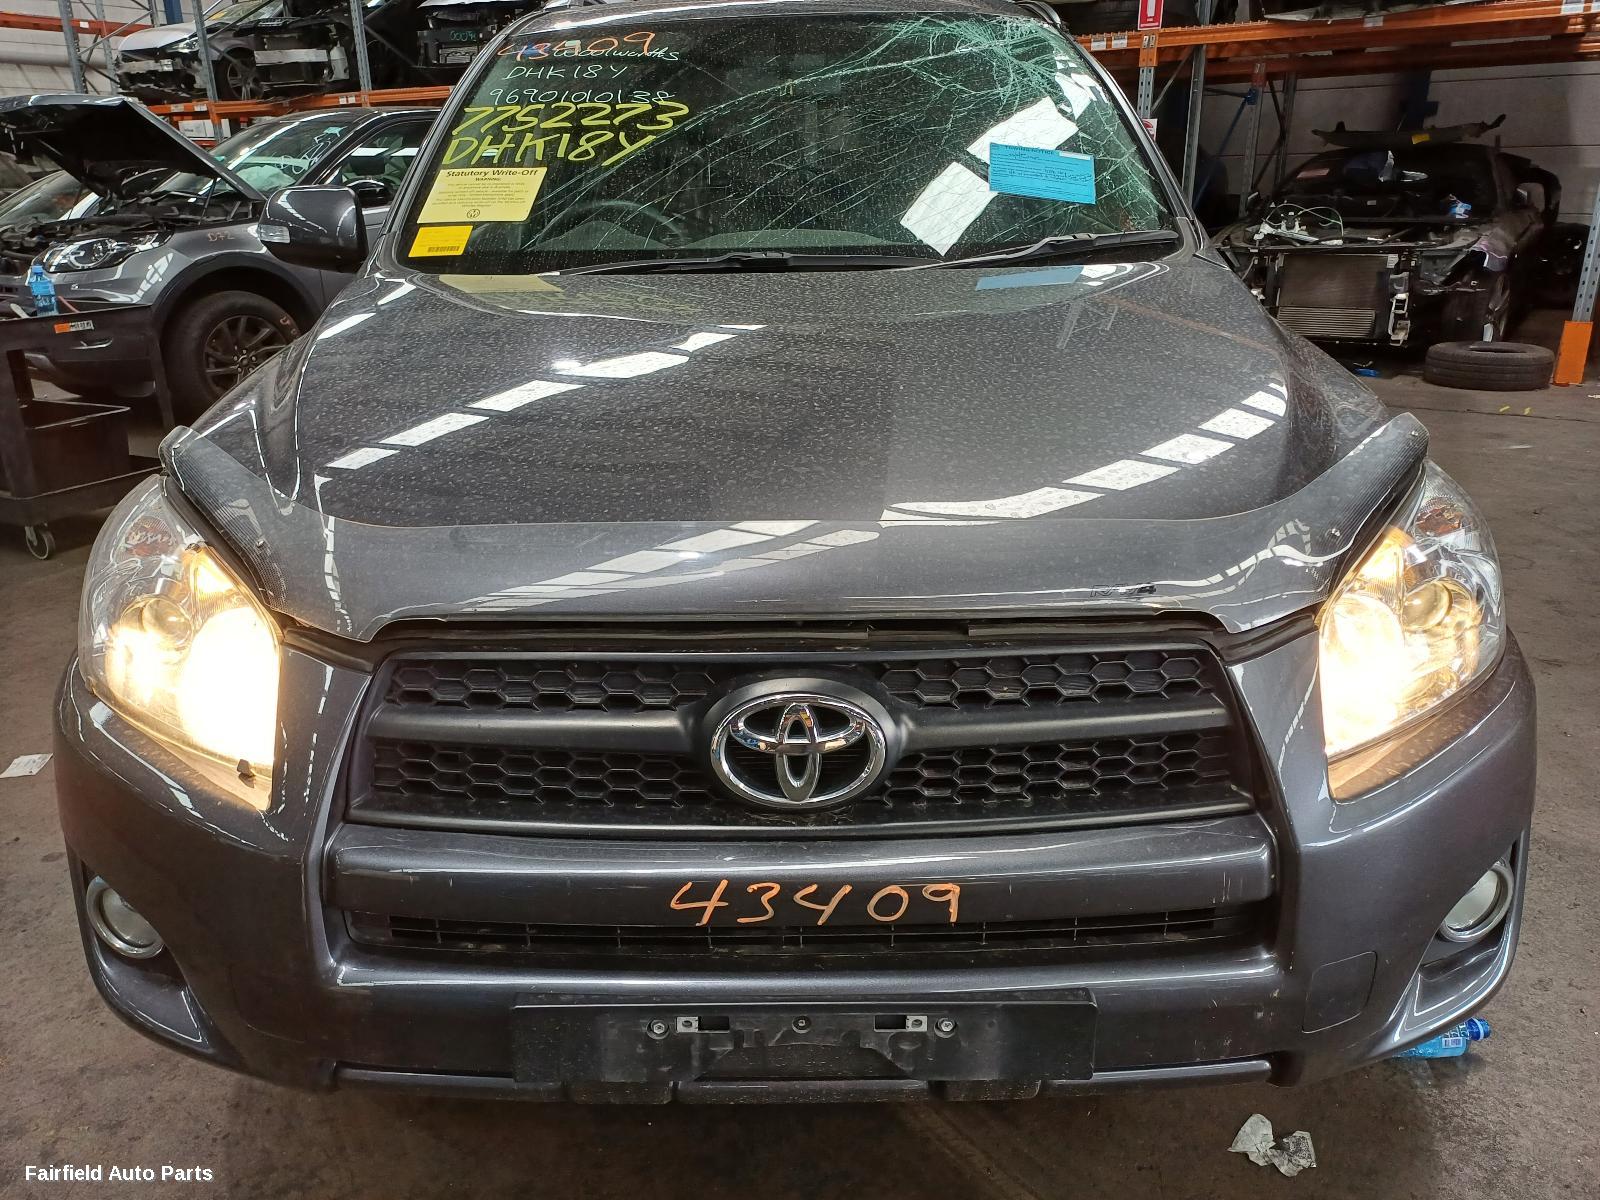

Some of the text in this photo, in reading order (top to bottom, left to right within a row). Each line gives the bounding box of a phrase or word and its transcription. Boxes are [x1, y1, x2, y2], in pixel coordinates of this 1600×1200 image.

[452, 102, 690, 135] 7752273
[441, 130, 656, 166] DHK18Y
[446, 168, 539, 178] Statutory Write-Off
[669, 879, 961, 927] 43409
